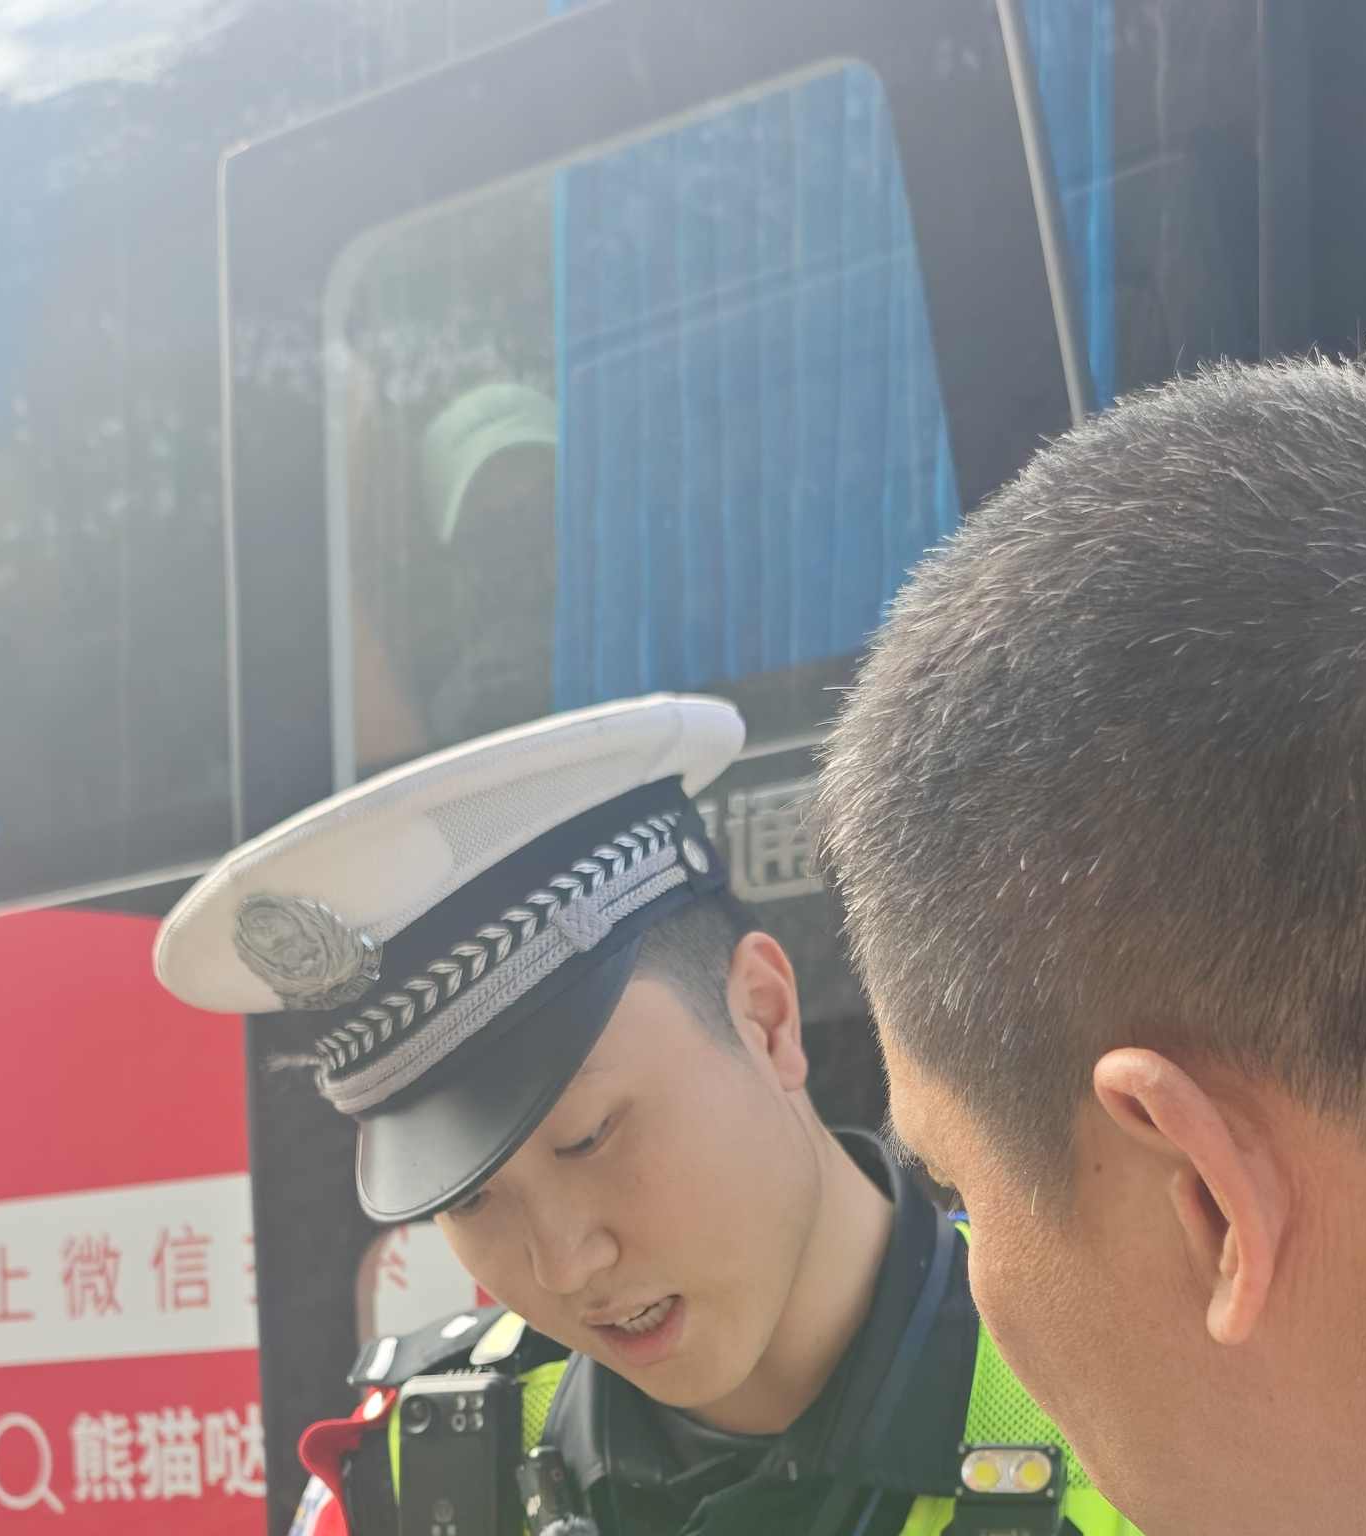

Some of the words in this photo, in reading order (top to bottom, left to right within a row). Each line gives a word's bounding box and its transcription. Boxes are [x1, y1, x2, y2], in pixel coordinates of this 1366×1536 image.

[697, 786, 825, 903] 通
[69, 1401, 268, 1503] 熊猫哒
